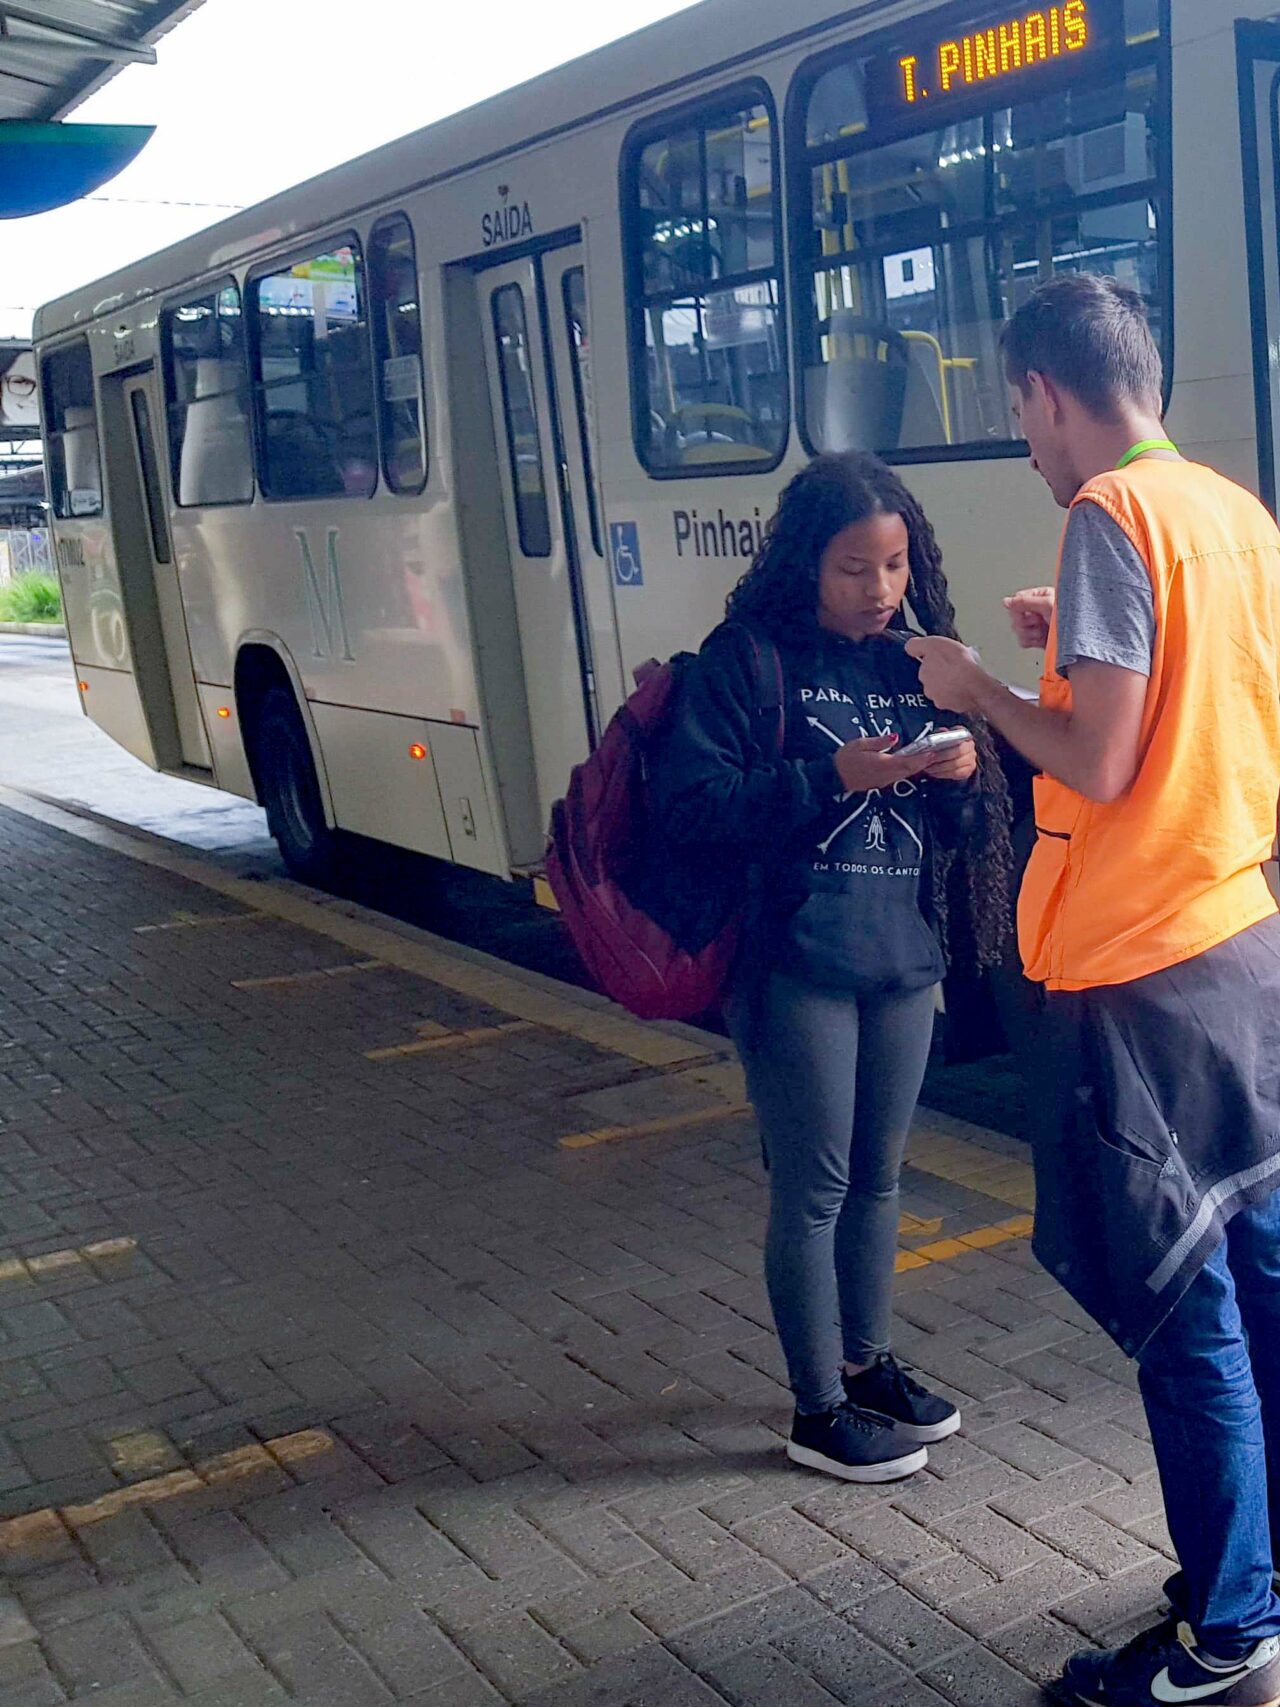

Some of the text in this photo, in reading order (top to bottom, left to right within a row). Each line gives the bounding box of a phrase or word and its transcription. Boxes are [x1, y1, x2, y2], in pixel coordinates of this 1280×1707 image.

[900, 0, 1087, 102] T. PINHAIS
[800, 687, 929, 709] PARA EMRE
[813, 862, 829, 871] EM
[834, 862, 868, 874] TODOS
[870, 866, 885, 875] OS
